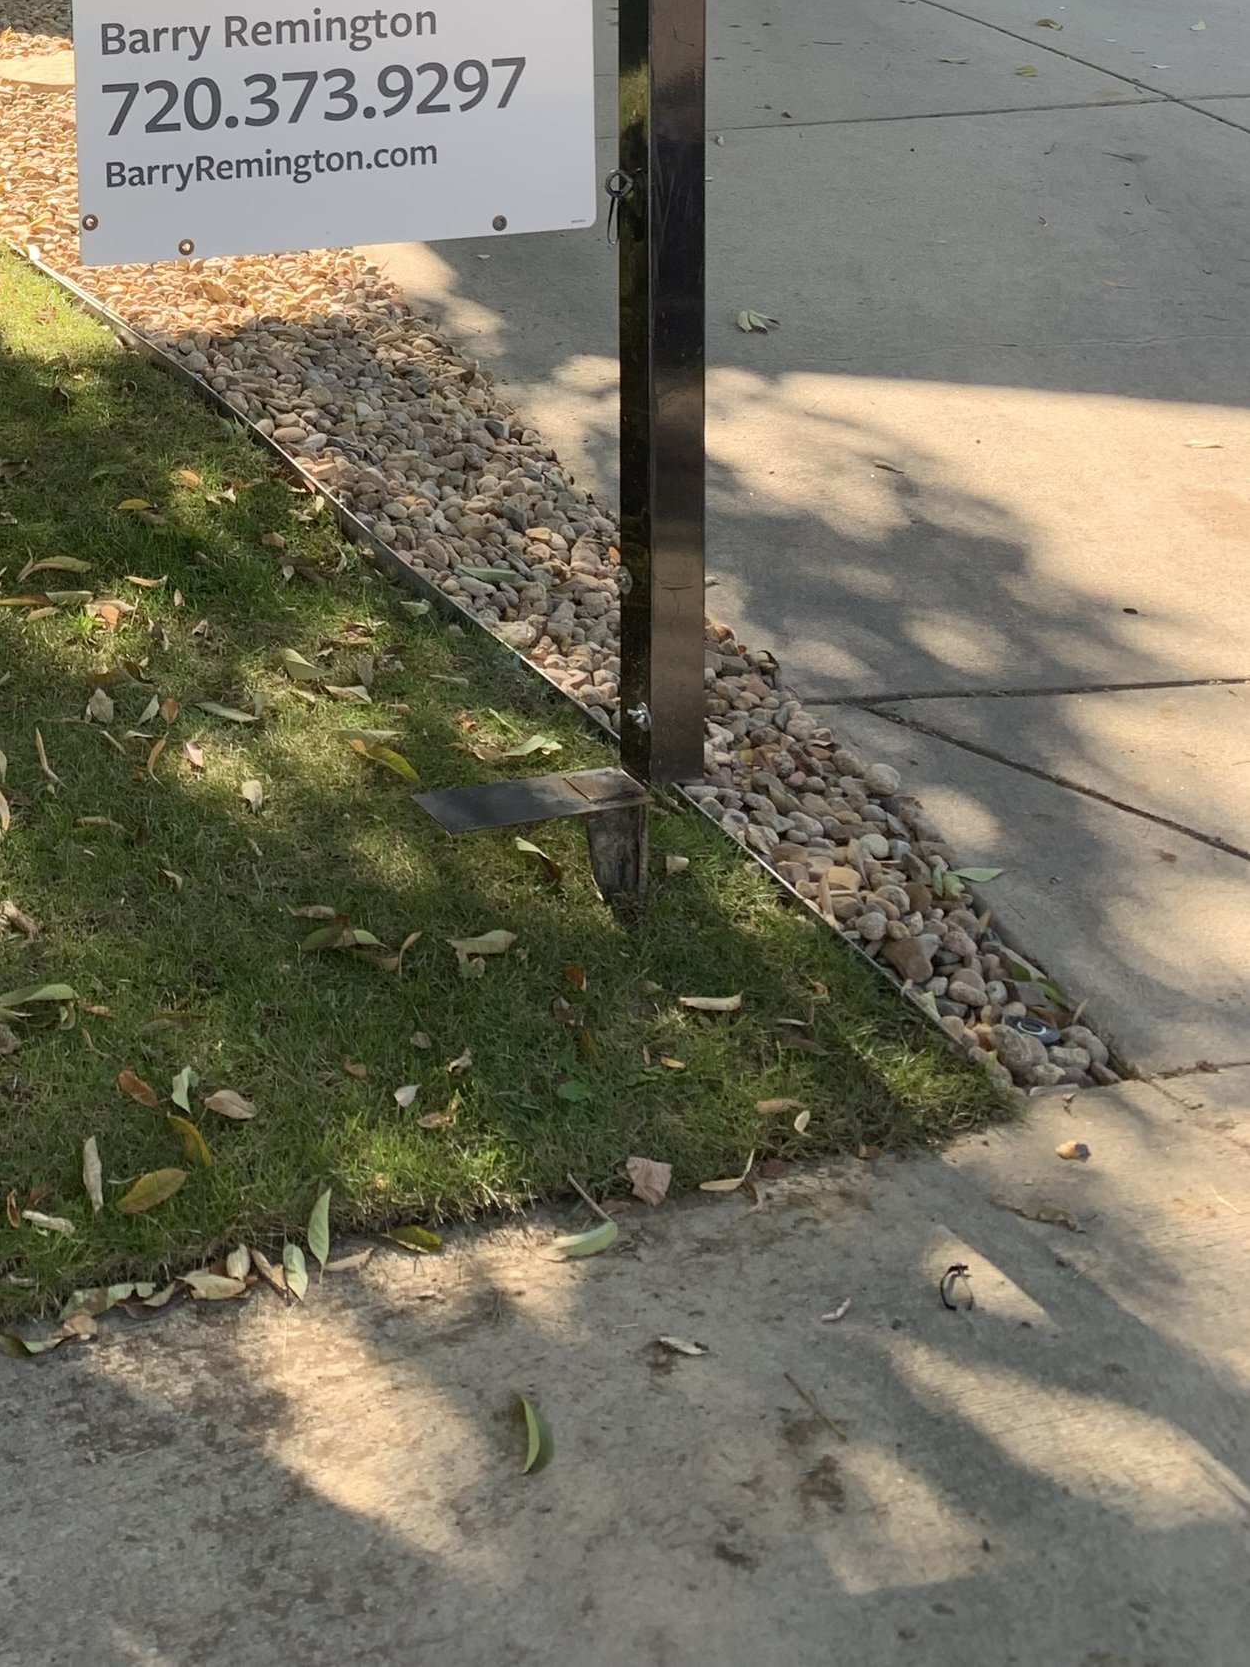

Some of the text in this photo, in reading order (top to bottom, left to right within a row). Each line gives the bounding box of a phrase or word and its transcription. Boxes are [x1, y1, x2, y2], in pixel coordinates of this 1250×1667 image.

[101, 7, 437, 62] Barry Remington
[101, 56, 526, 137] 720.373.9297
[106, 144, 437, 192] BarryRemington.com
